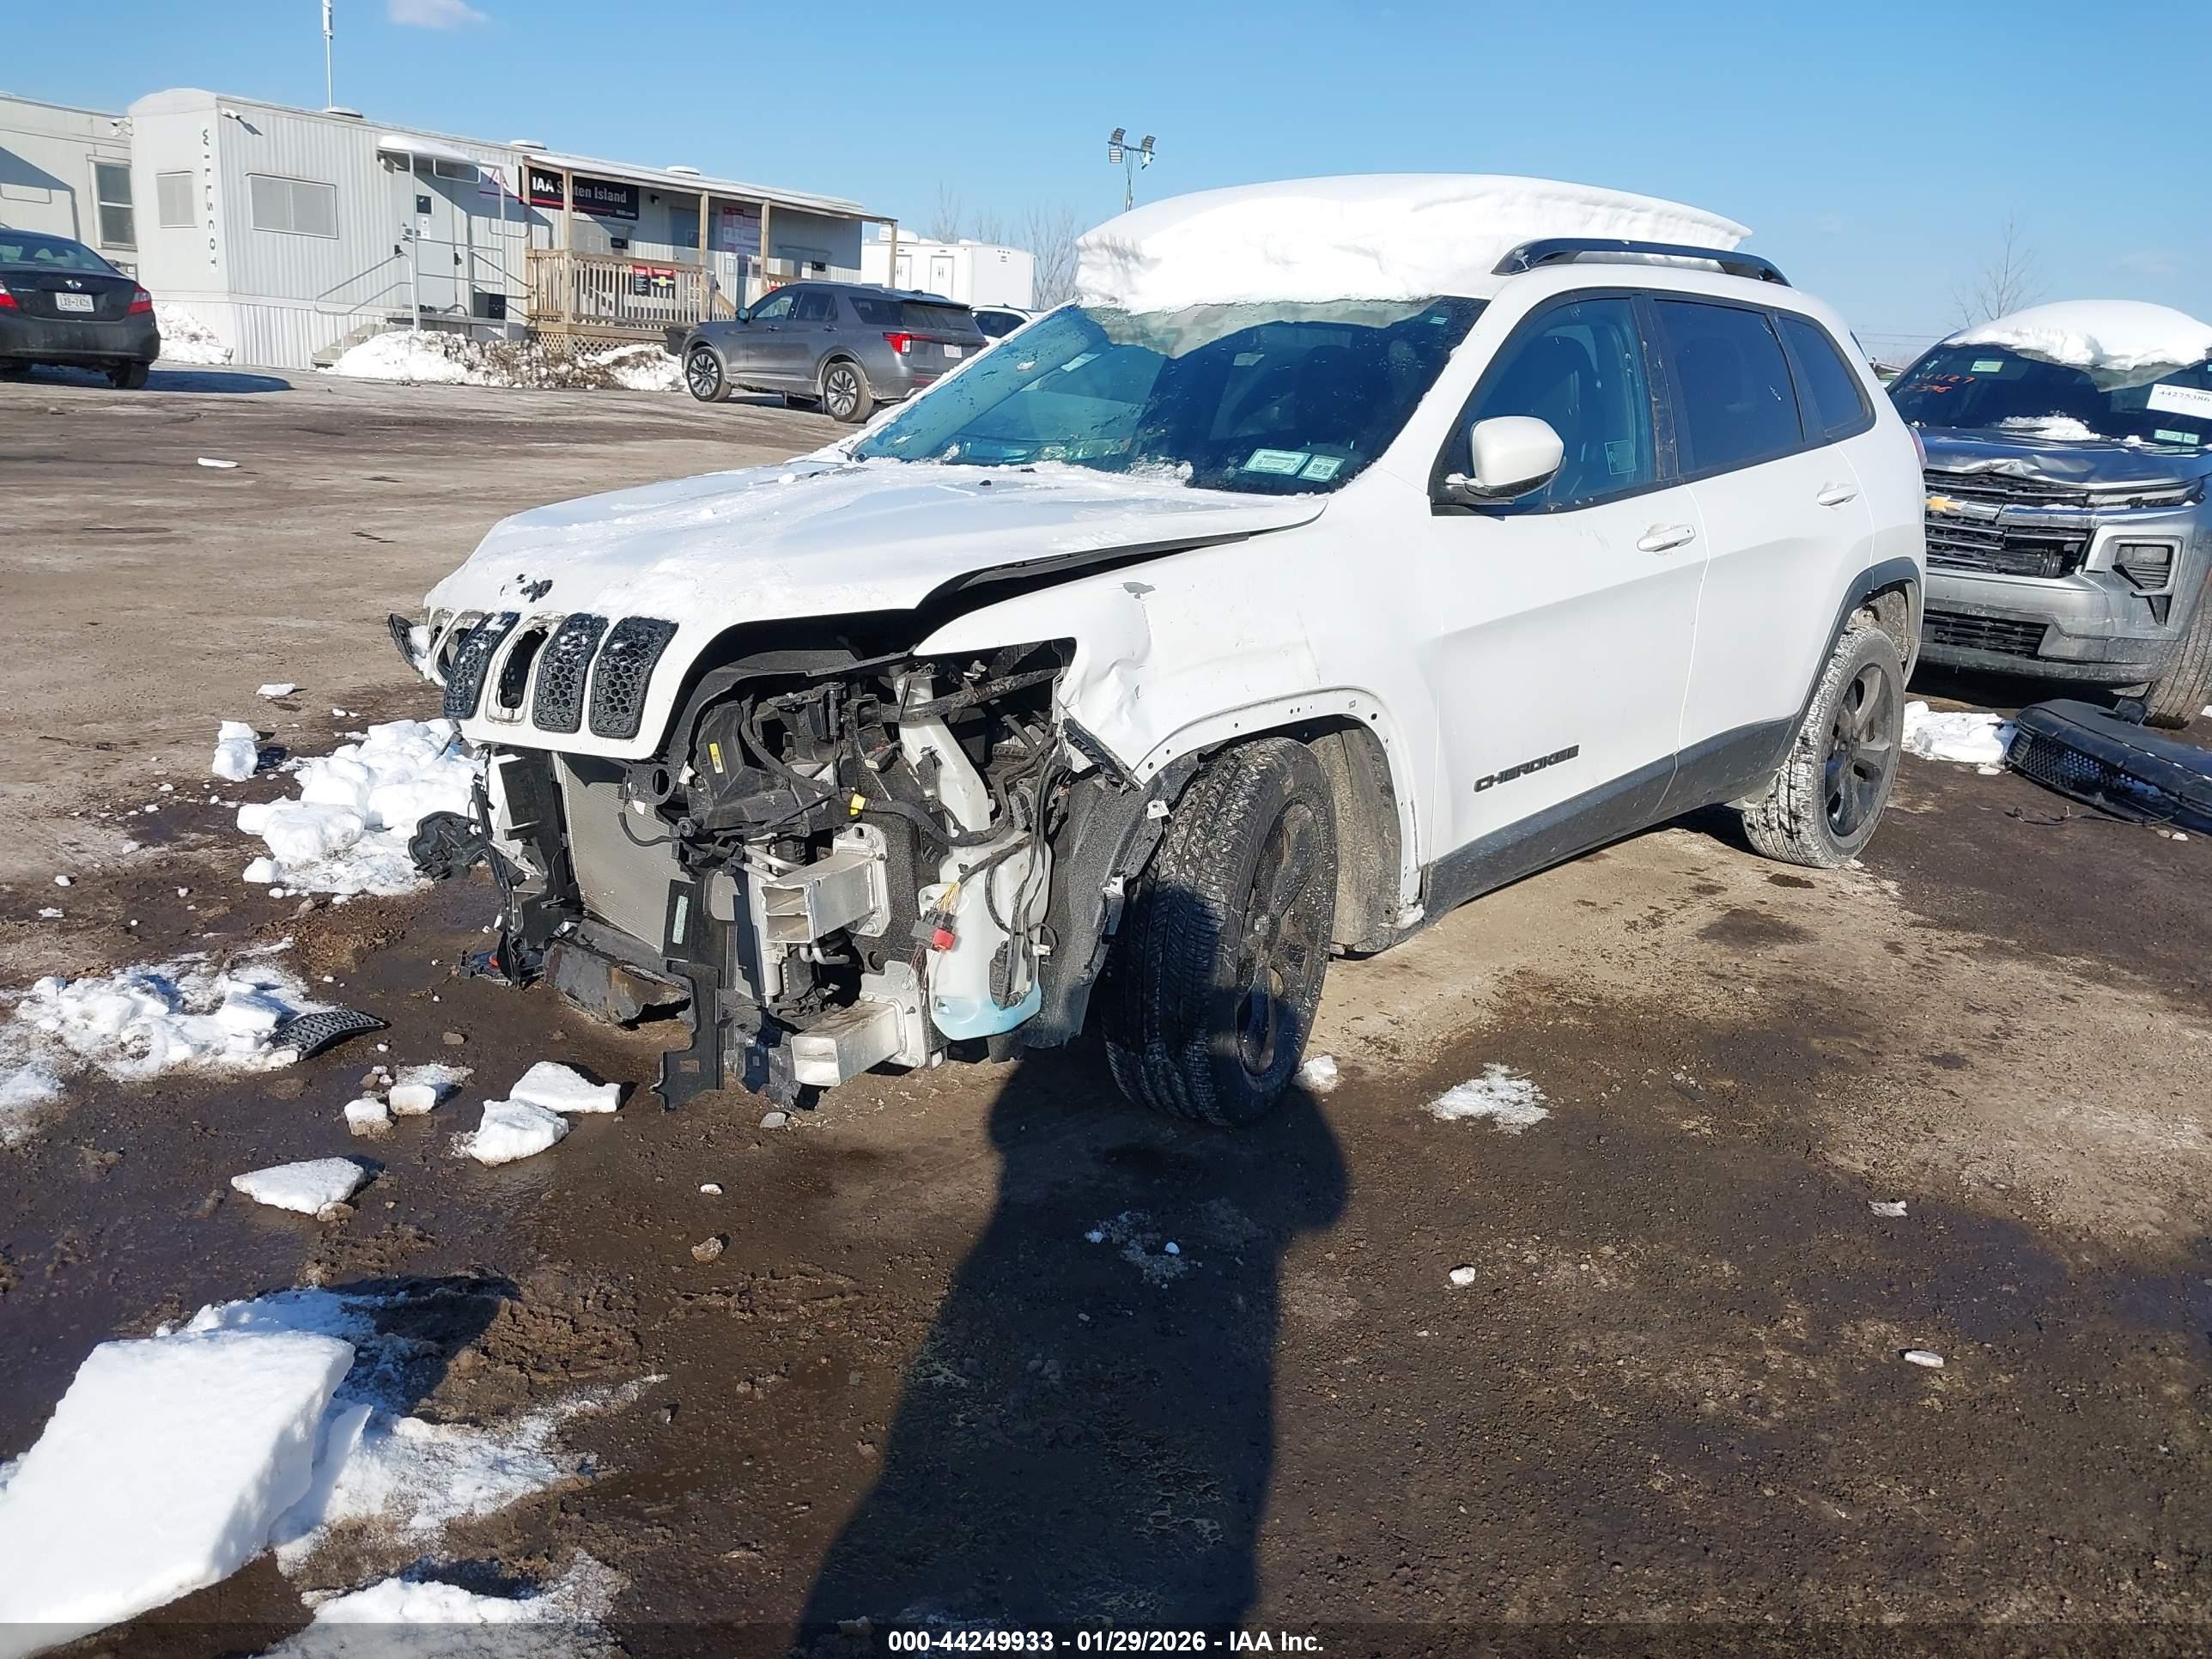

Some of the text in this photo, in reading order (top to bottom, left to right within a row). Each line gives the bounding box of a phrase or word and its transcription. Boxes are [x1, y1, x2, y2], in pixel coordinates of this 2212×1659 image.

[202, 128, 217, 268] WILLSCOT
[532, 176, 627, 204] IAA Sten Island
[1474, 744, 1579, 793] CHEROKEE
